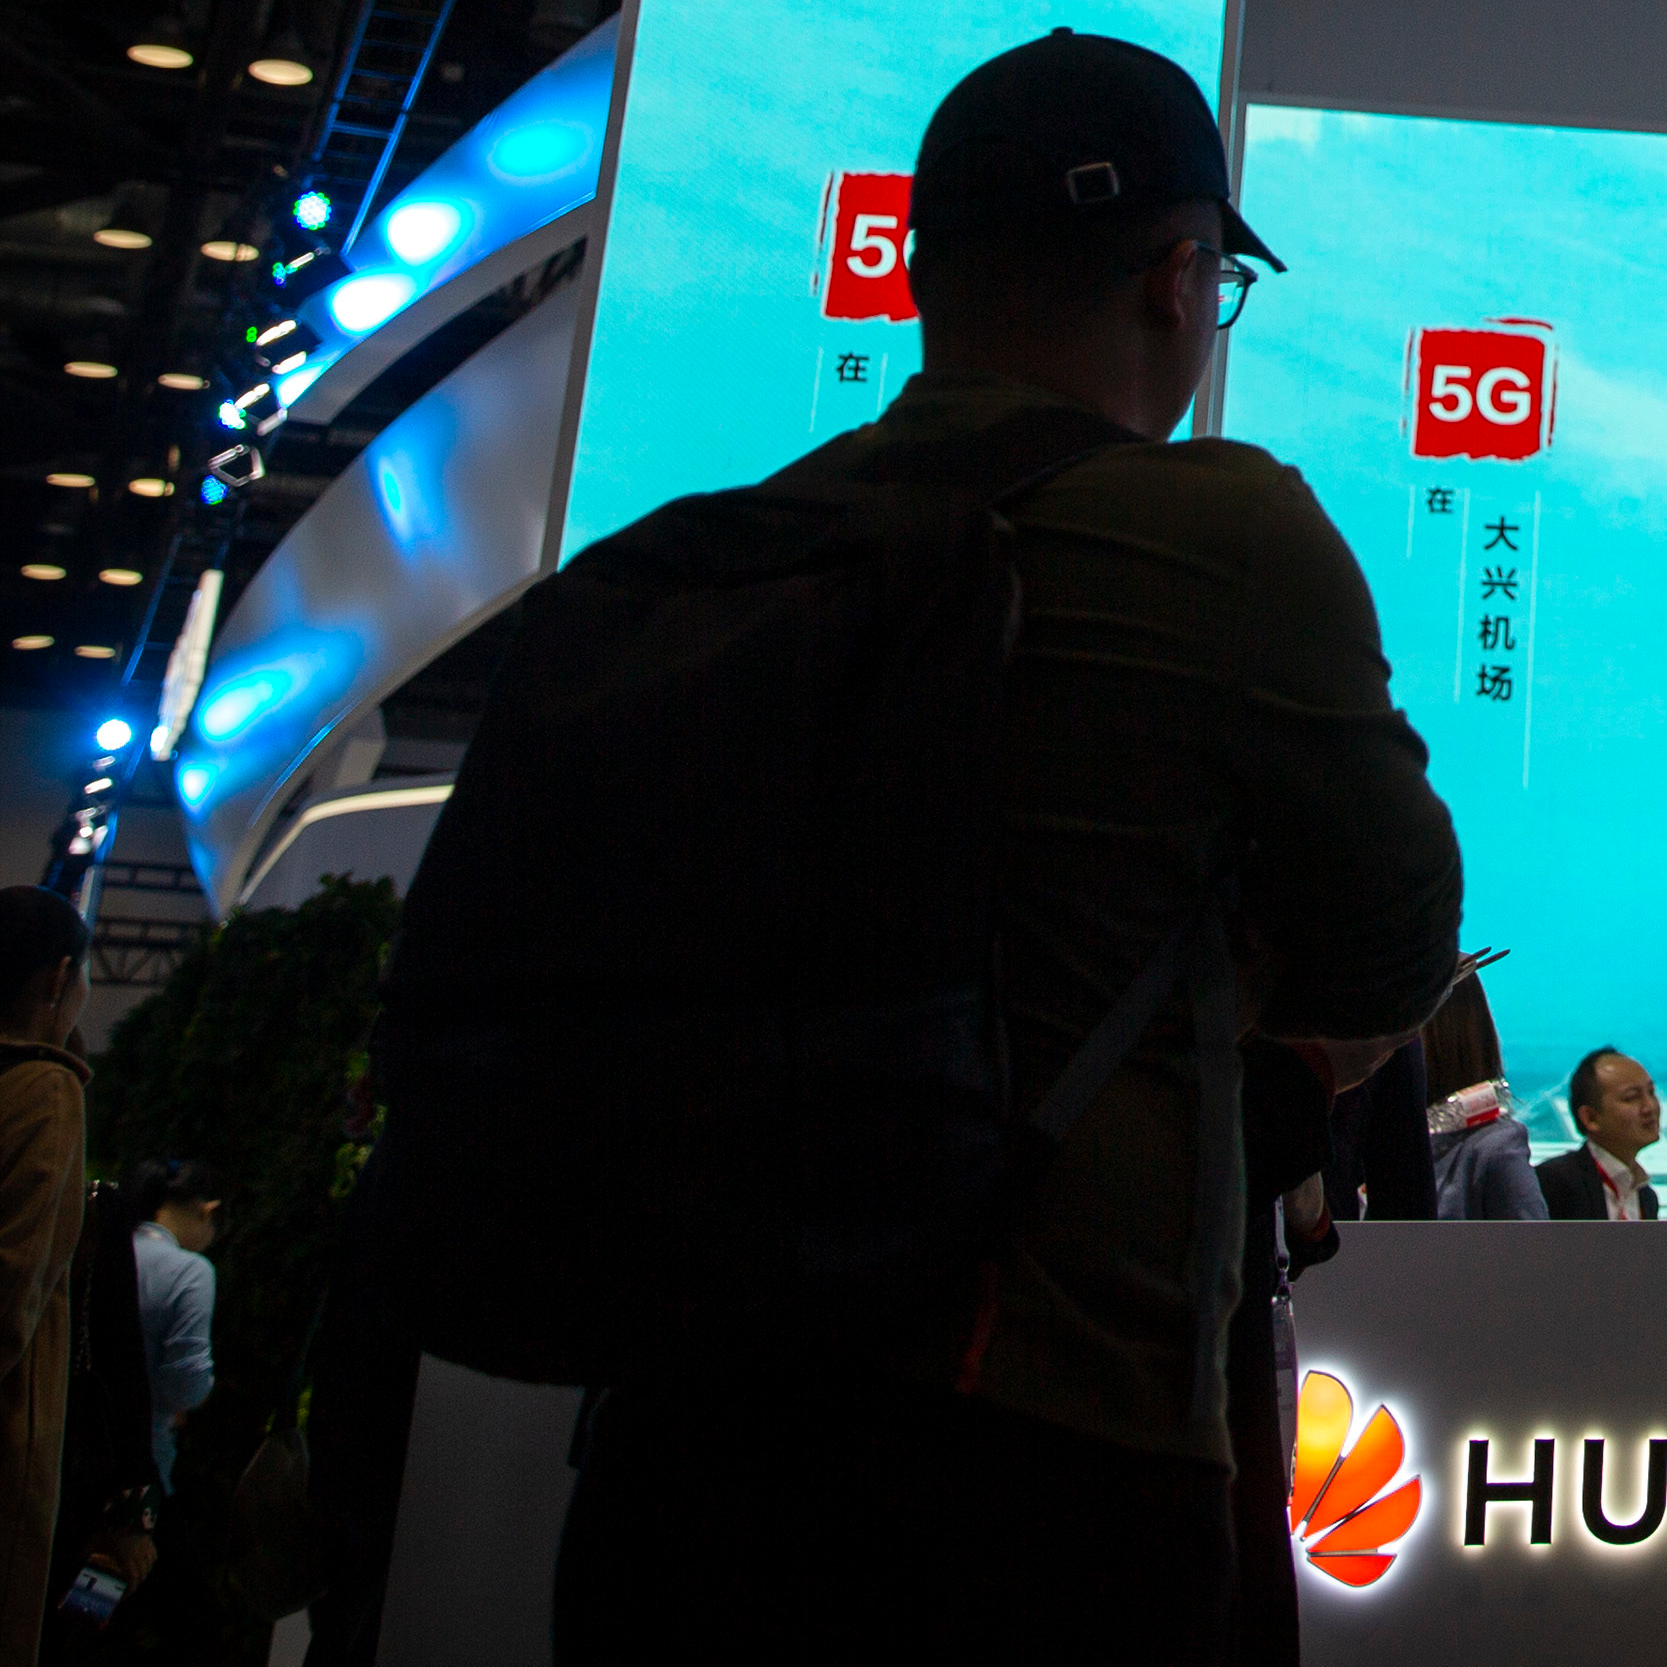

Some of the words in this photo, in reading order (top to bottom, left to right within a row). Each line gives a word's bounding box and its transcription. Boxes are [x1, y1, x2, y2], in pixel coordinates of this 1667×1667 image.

[846, 213, 914, 279] 5
[836, 352, 869, 384] 在
[1428, 364, 1532, 425] 5G
[1426, 487, 1453, 515] 在
[1475, 515, 1520, 702] 大兴机场
